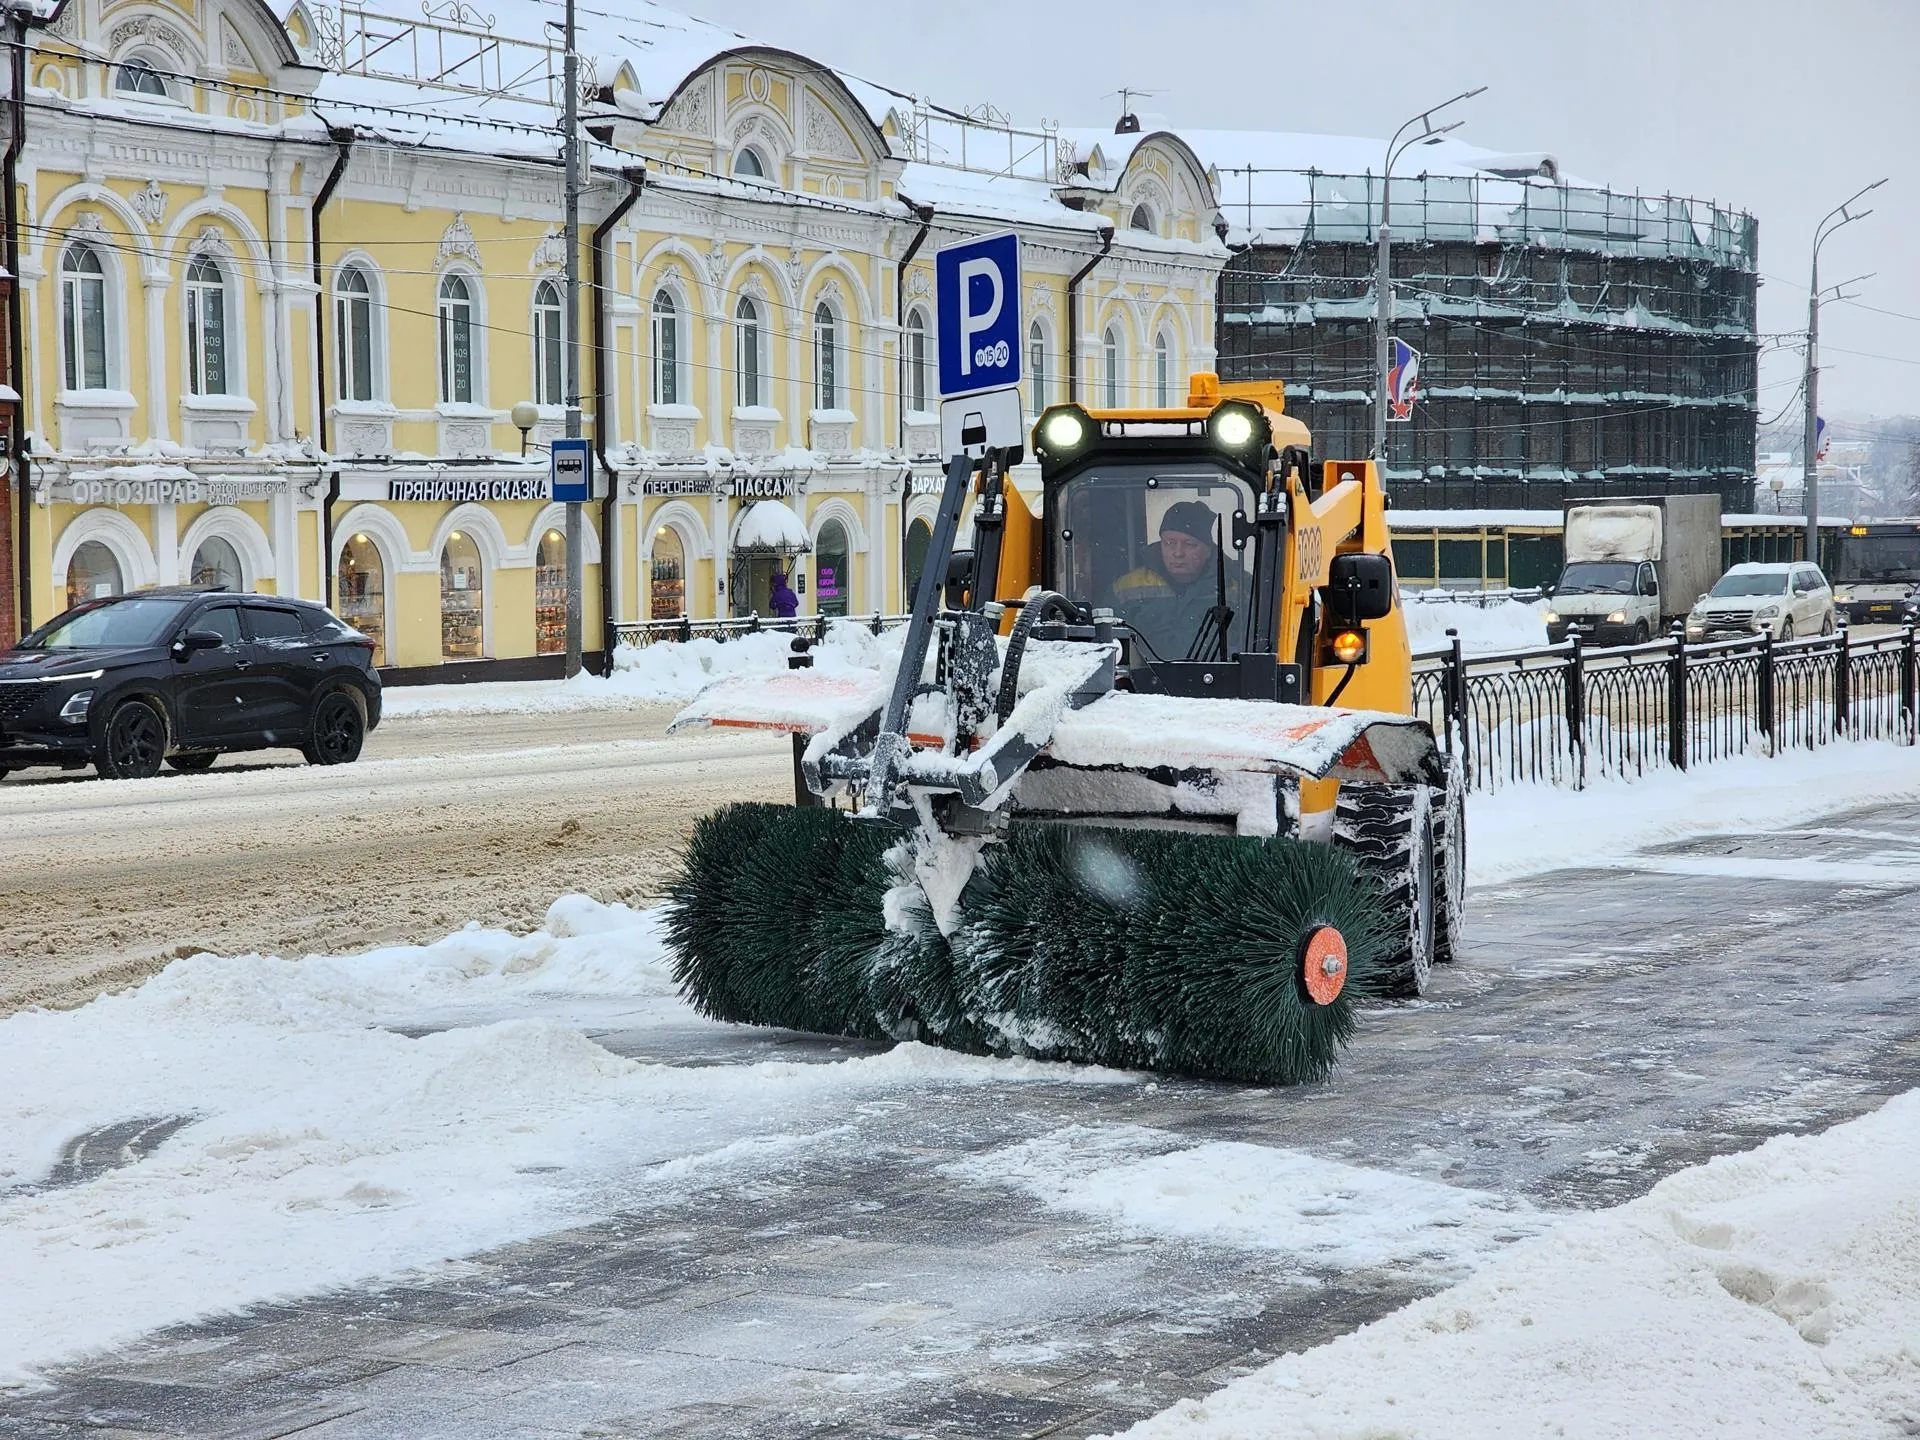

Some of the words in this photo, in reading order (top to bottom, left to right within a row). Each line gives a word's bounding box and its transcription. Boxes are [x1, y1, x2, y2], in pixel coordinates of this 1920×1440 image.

[208, 303, 214, 312] 8
[959, 257, 1004, 376] P
[204, 336, 221, 347] 409
[207, 353, 218, 364] 20
[977, 353, 984, 364] 10
[986, 350, 994, 362] 15
[996, 346, 1008, 361] 20
[456, 364, 466, 374] 20
[207, 370, 219, 381] 20
[663, 370, 672, 380] 20
[456, 379, 466, 389] 20
[663, 384, 672, 394] 20
[72, 480, 200, 504] ОРТОЗДРАВ
[391, 480, 489, 501] ПРЯНИЧНАЯ
[491, 480, 549, 500] СКАЗКА
[645, 481, 695, 495] ПЕРСОНА
[735, 478, 794, 496] ПАССАЖ
[208, 494, 240, 505] САЛОН
[1298, 526, 1323, 580] 1000
